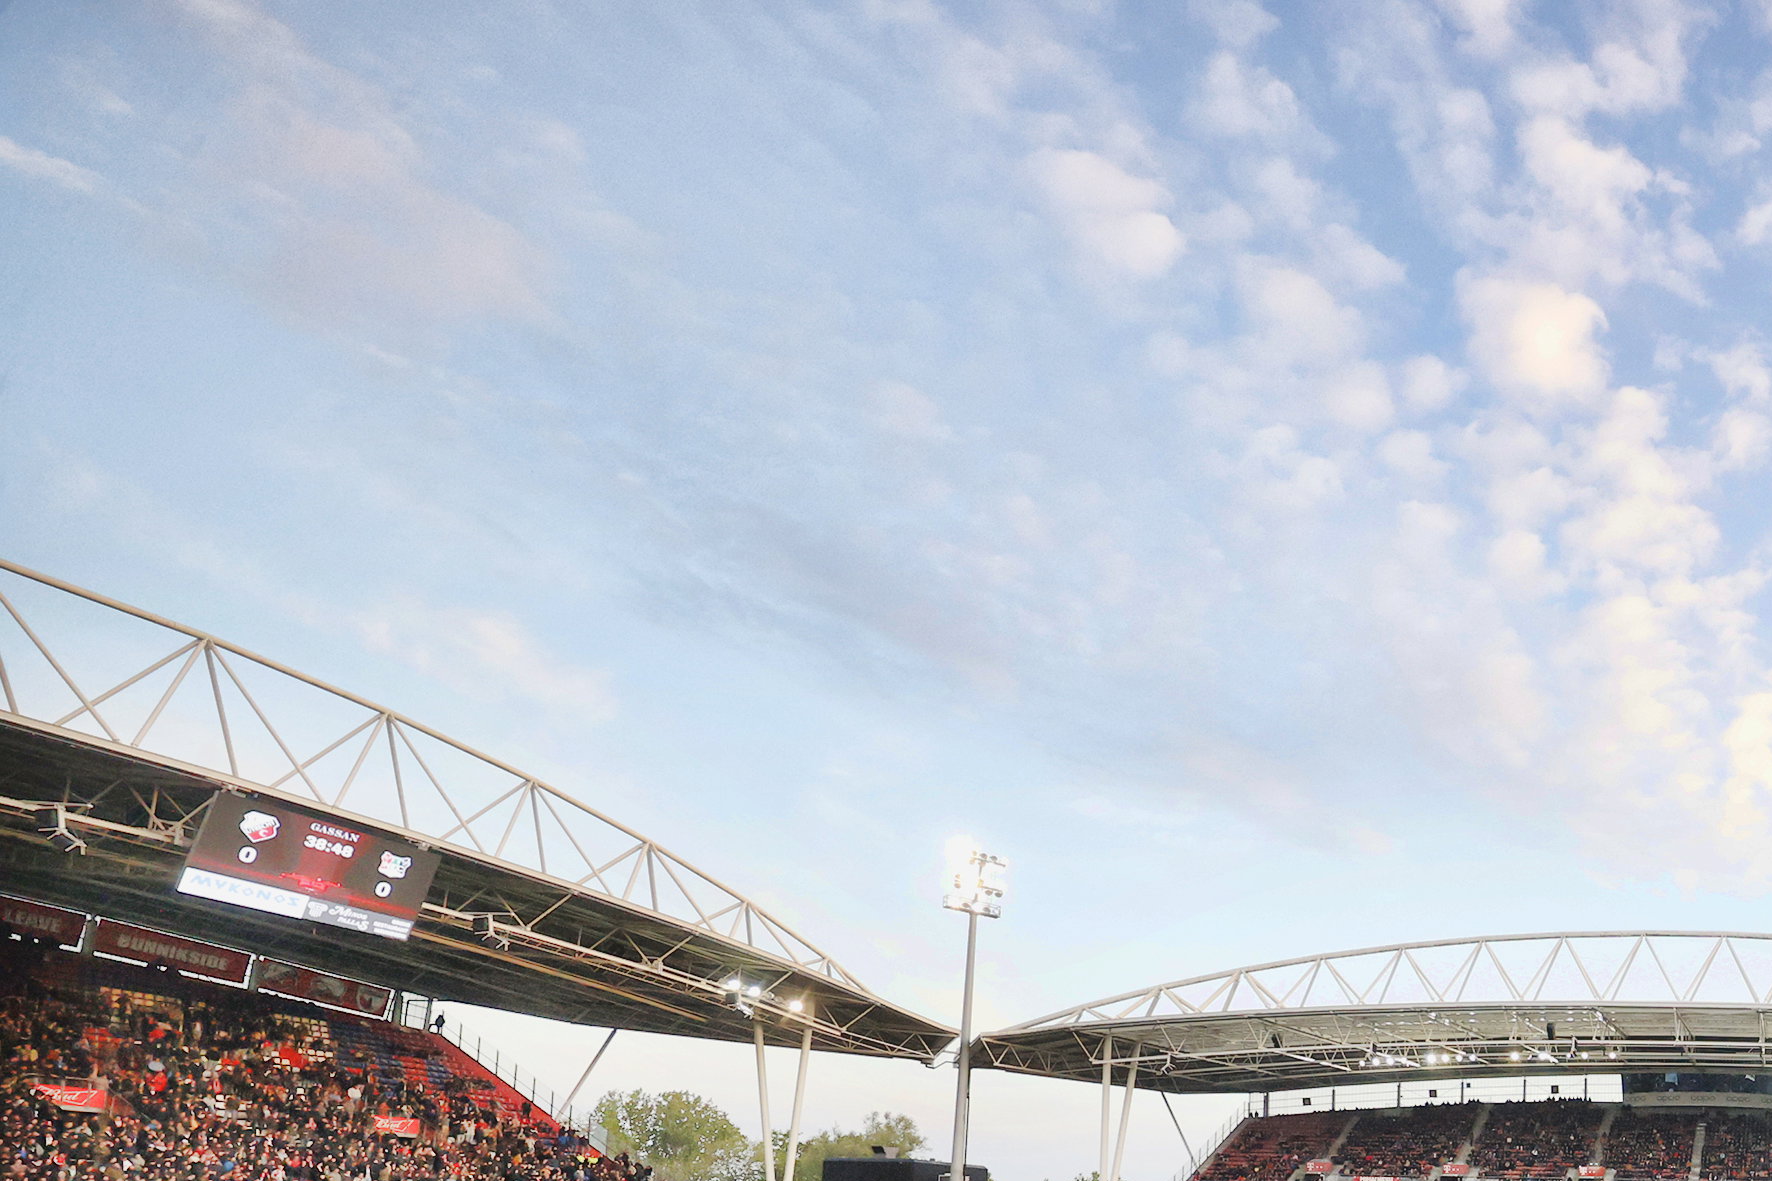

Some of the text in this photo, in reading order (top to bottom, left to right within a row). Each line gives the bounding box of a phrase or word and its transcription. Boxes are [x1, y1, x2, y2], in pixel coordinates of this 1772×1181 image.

[309, 821, 360, 843] GASSAN
[238, 845, 258, 864] 0
[191, 874, 300, 908] MYKONOS
[374, 881, 392, 898] 0
[116, 933, 230, 971] BUNNIKSIDE
